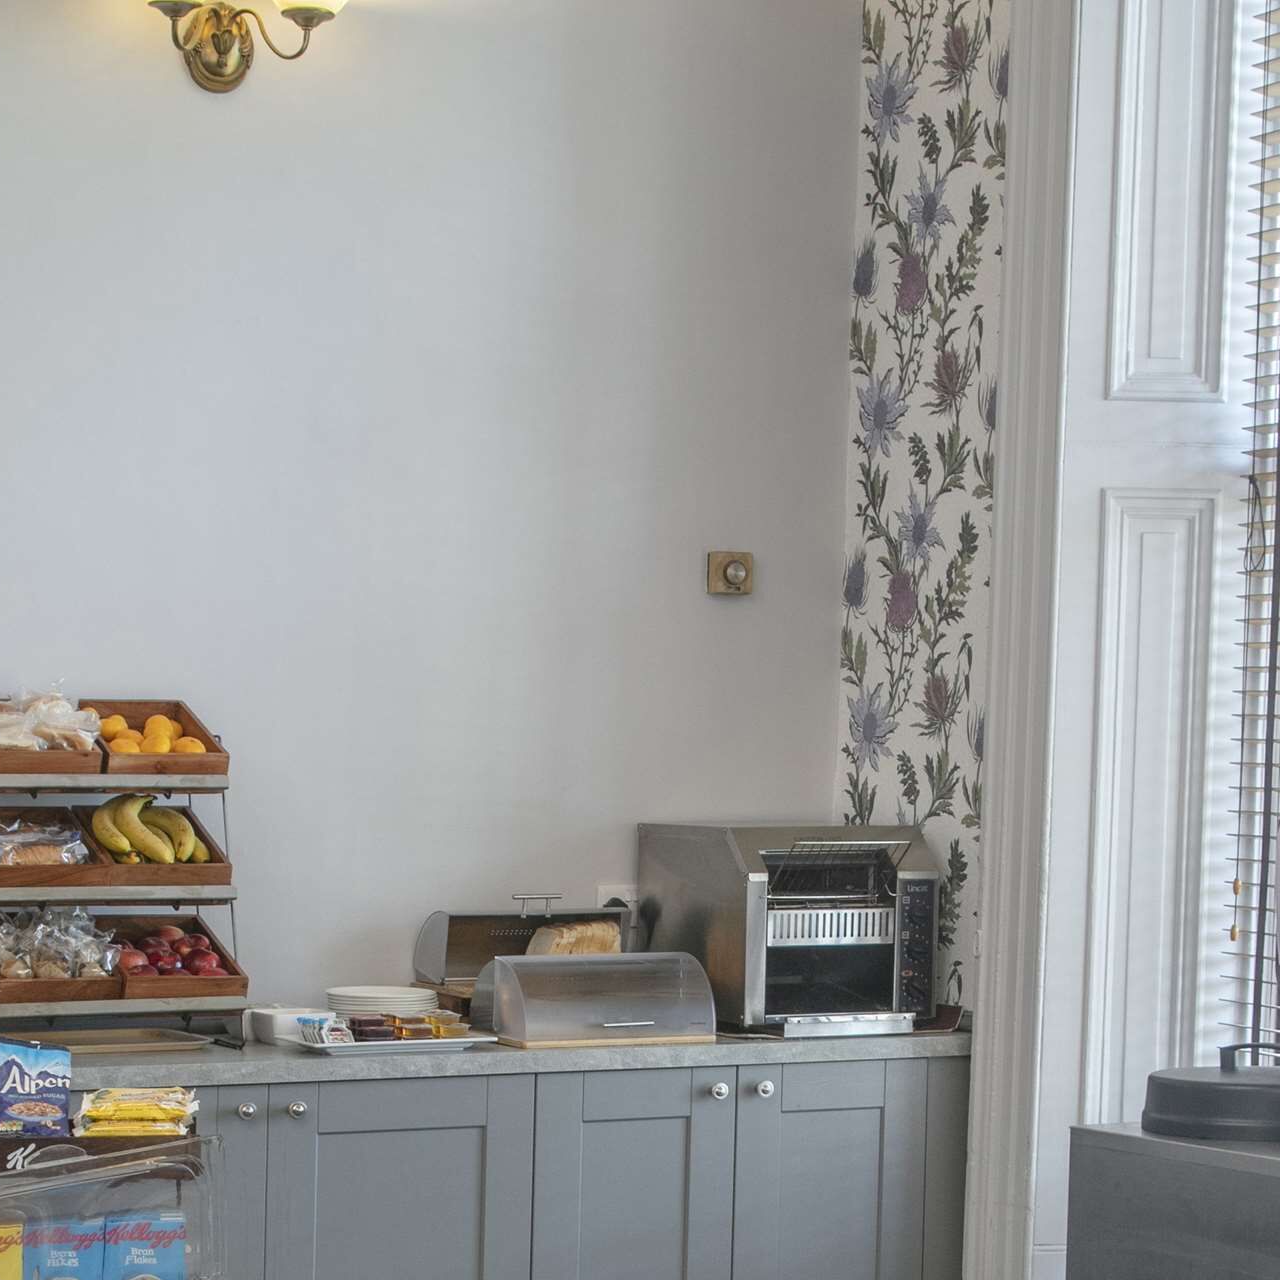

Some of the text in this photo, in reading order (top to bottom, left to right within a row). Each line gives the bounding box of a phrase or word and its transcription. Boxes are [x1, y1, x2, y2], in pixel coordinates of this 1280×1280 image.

[0, 1065, 70, 1094] Alpen
[24, 1226, 105, 1250] Kellogg's
[104, 1221, 187, 1248] Kellogg's
[131, 1247, 154, 1256] Bran
